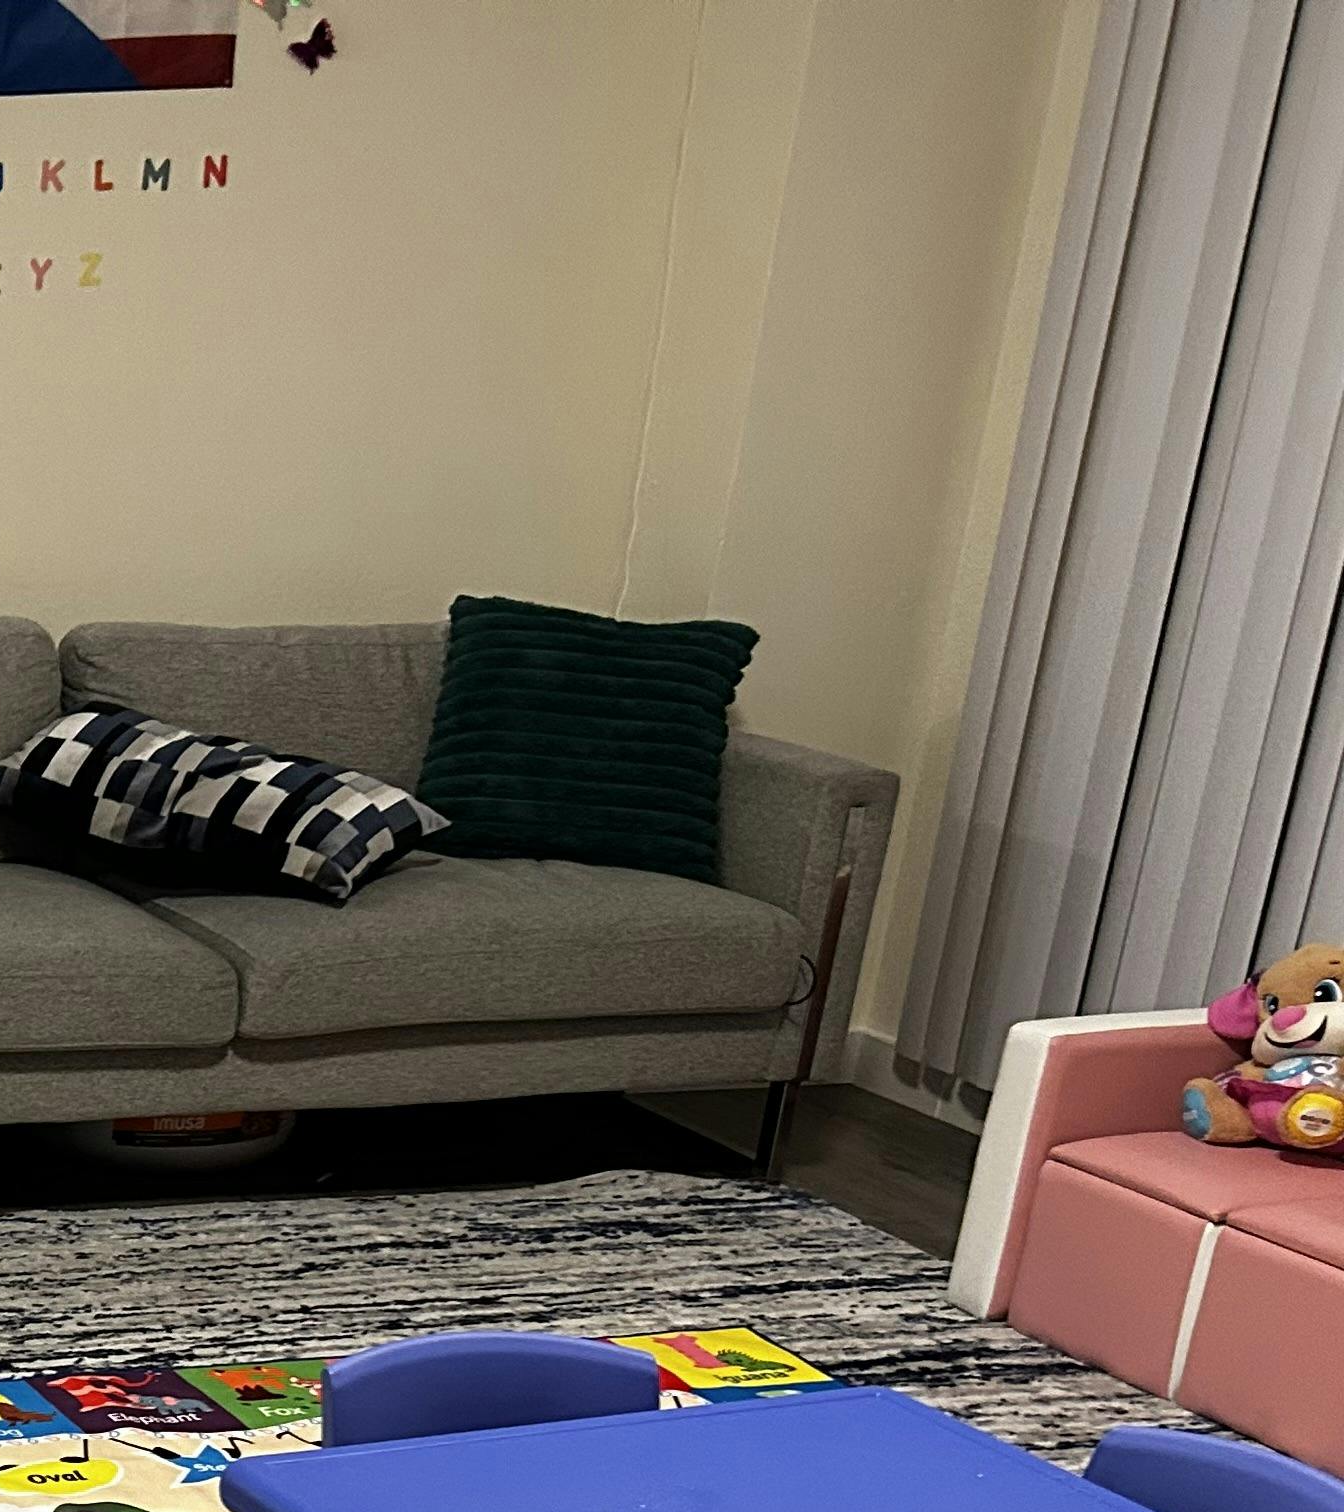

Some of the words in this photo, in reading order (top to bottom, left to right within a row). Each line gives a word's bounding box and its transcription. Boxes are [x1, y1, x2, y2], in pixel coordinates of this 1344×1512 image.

[40, 159, 66, 193] K
[94, 159, 113, 192] L
[141, 158, 171, 191] M
[203, 154, 228, 189] N
[30, 257, 53, 291] Y
[79, 252, 103, 287] Z
[153, 1115, 207, 1131] imusa
[653, 1333, 730, 1369] I
[108, 1411, 203, 1426] Elephant
[258, 1405, 308, 1418] Fox
[193, 1463, 229, 1472] Sta
[26, 1469, 88, 1485] Oval
